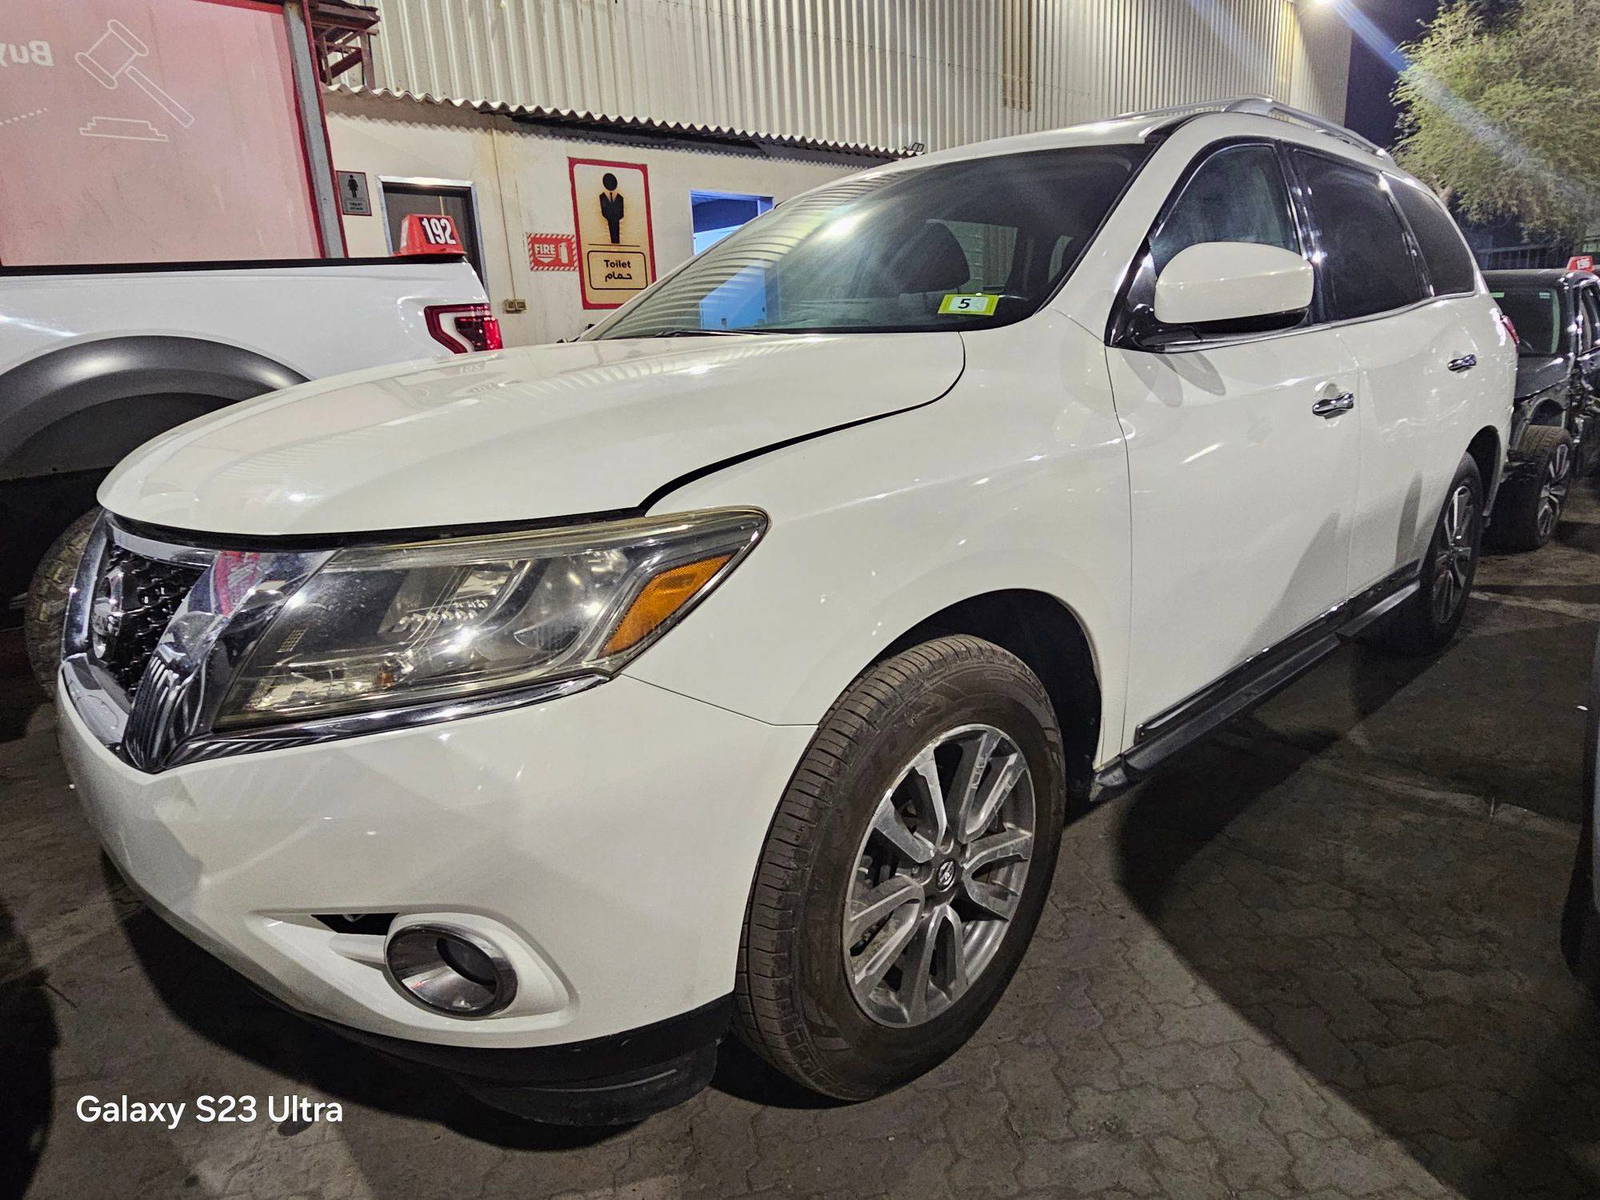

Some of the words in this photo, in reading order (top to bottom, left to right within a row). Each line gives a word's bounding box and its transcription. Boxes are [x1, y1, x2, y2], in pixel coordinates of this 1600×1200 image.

[422, 217, 456, 245] 192
[534, 243, 556, 255] FIRE
[603, 259, 631, 269] Toilet
[604, 271, 632, 283] حمام
[957, 298, 971, 310] 5
